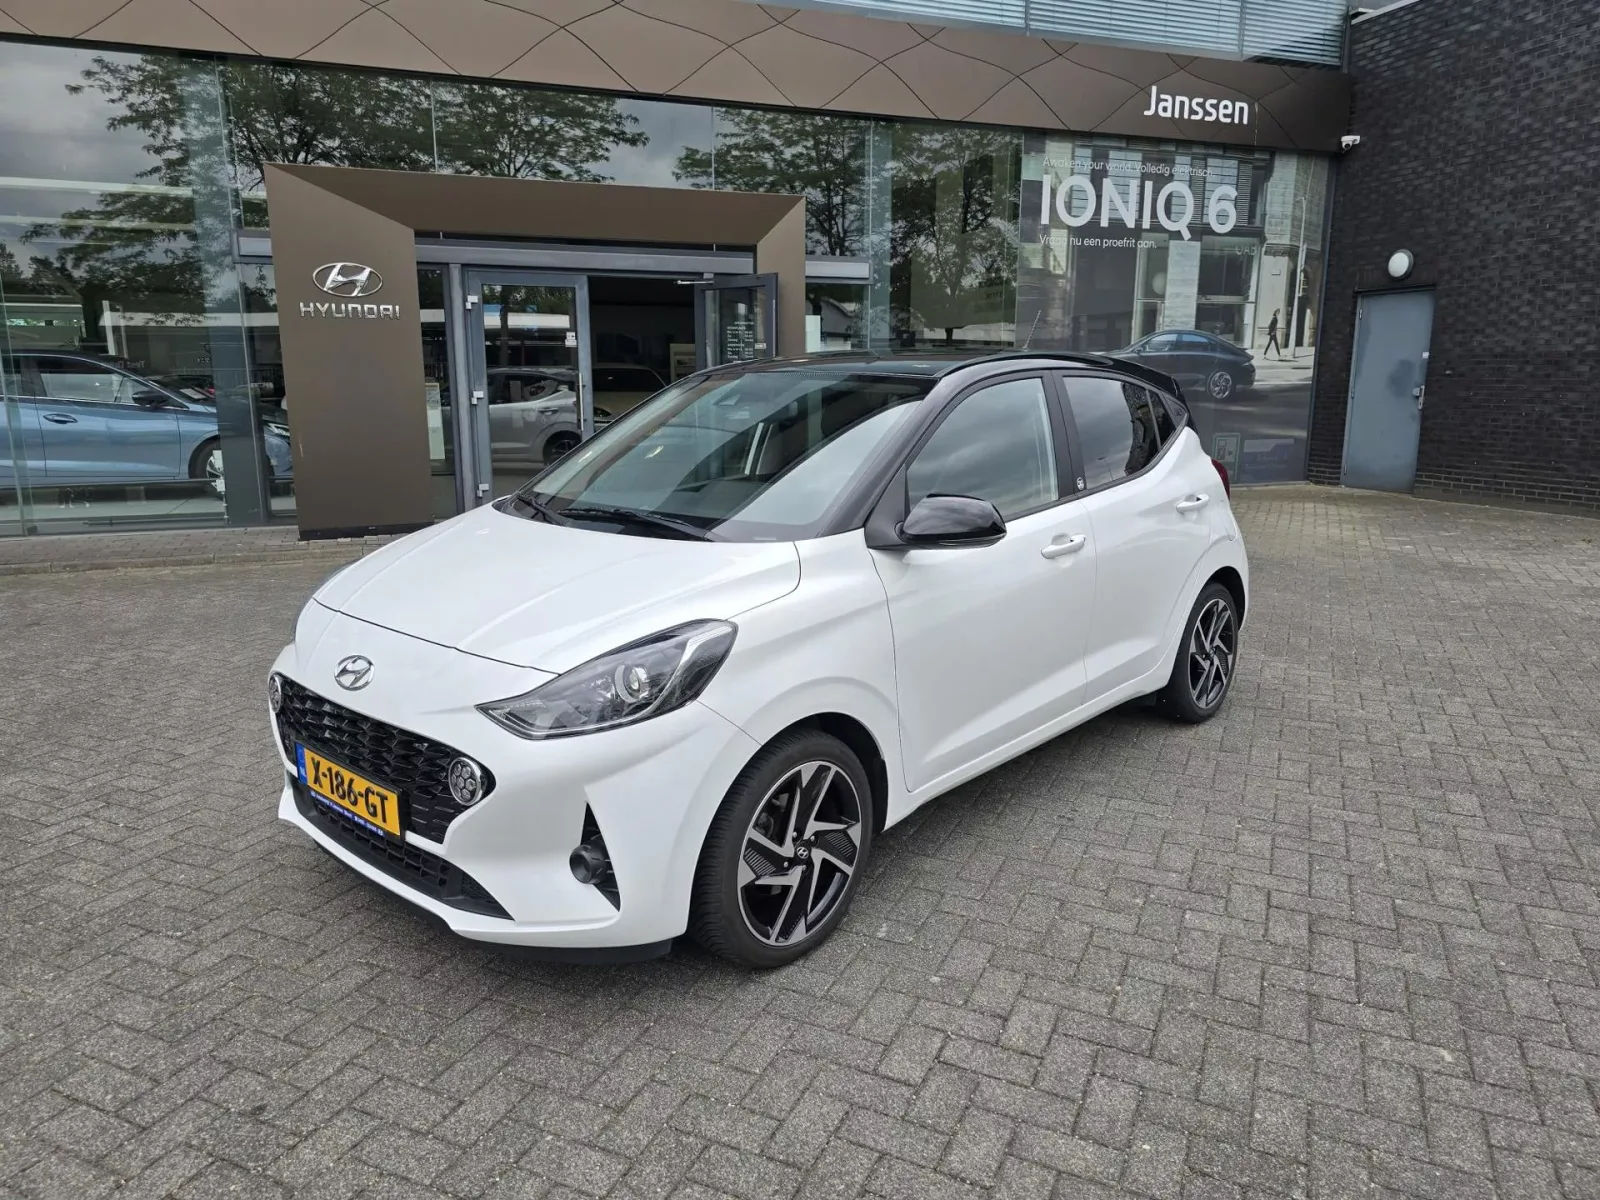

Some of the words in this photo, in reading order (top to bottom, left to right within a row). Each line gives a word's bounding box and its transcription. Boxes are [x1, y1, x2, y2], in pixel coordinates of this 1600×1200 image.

[1143, 85, 1250, 125] Janssen
[1042, 155, 1081, 169] Awaken
[1083, 160, 1104, 173] your
[1106, 160, 1132, 171] world.
[1134, 161, 1170, 176] Volledig
[1171, 163, 1216, 178] elektrisch.
[1040, 174, 1195, 241] IONIQ
[1207, 184, 1239, 234] 6
[1039, 233, 1068, 249] Vraag
[1069, 237, 1082, 246] nu
[1083, 238, 1101, 247] een
[1102, 237, 1136, 249] proefrit
[299, 301, 400, 320] HYUNDAI
[311, 756, 389, 824] X-186-GT
